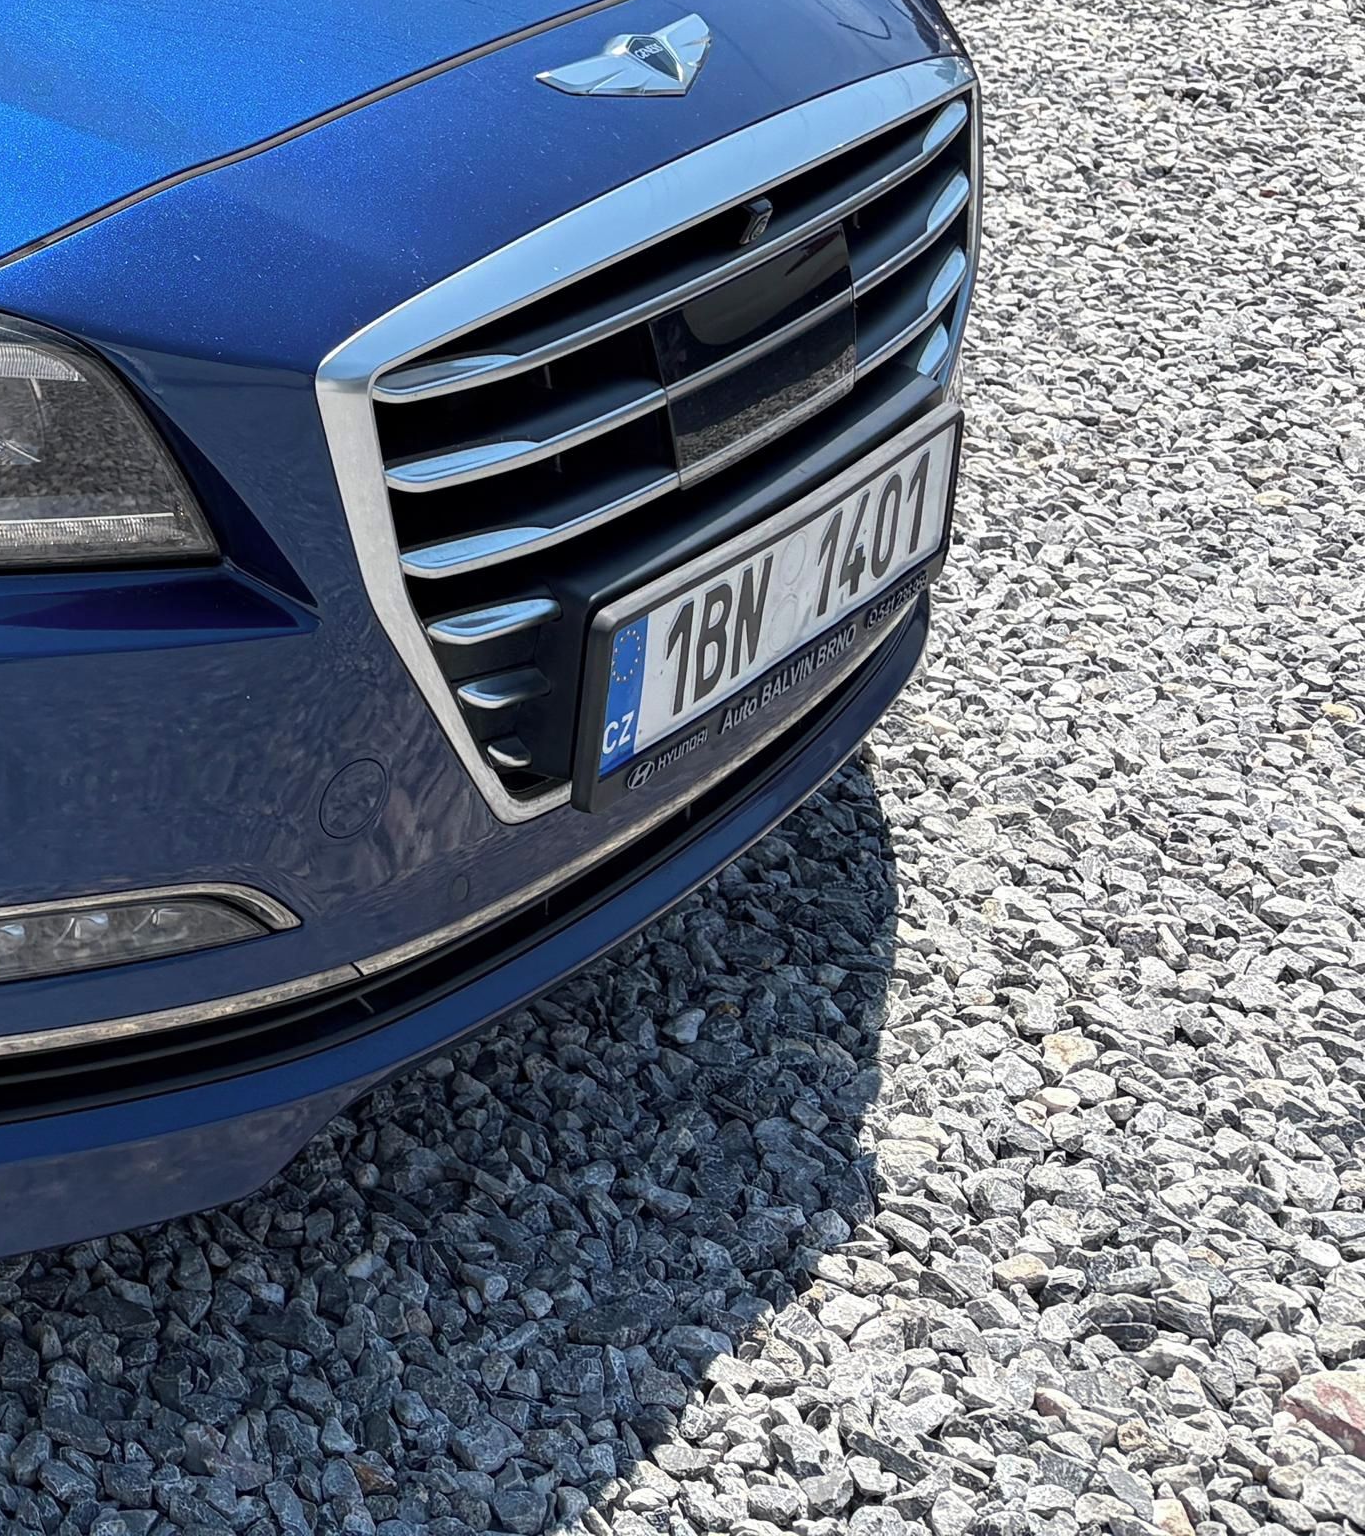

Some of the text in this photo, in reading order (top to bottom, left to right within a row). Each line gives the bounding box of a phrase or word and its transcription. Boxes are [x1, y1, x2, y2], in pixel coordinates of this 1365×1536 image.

[666, 450, 930, 717] 1BN 1401
[602, 711, 634, 755] CZ
[657, 728, 709, 771] HYUNDAI
[721, 700, 758, 735] Auto
[760, 654, 817, 711] BALVIN
[815, 623, 857, 671] BRNO
